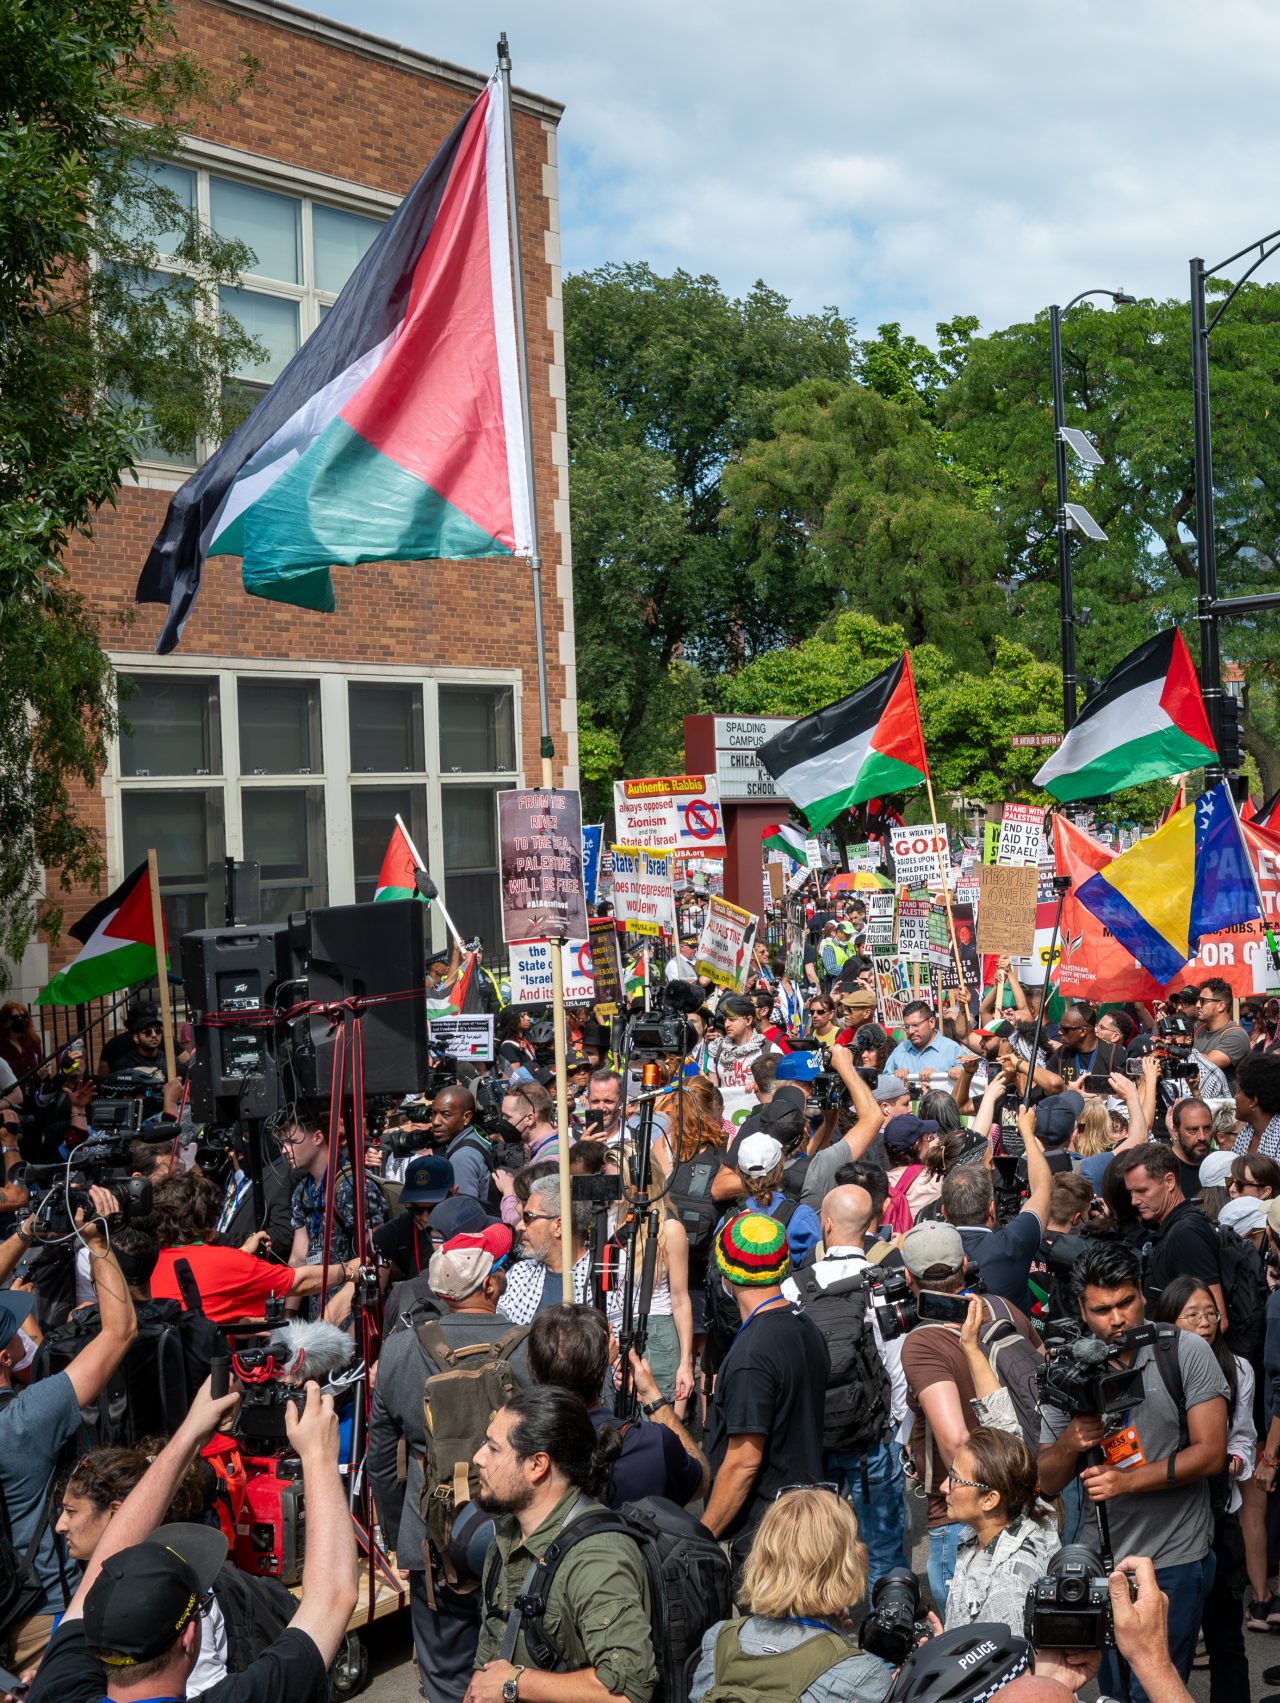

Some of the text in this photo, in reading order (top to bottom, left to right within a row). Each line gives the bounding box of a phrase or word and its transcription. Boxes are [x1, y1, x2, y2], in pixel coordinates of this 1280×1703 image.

[726, 722, 766, 733] SPALDING
[729, 736, 764, 746] CAMPUS
[627, 779, 703, 795] Authentic Rabbis
[747, 783, 777, 795] SCHOOL
[518, 795, 566, 810] FROM THE
[619, 799, 673, 814] always opposed
[1005, 805, 1045, 817] STAND WITH
[530, 815, 558, 830] RIVER
[627, 816, 666, 829] Zionism
[1004, 812, 1044, 824] PALESTINE!
[893, 829, 933, 839] THE WRATH
[1004, 823, 1040, 835] END U.S
[514, 836, 551, 851] TO THE
[653, 833, 677, 845] Israel
[1002, 833, 1039, 847] AID TO
[895, 837, 947, 856] GOD
[1001, 844, 1038, 858] ISRAEL!
[516, 857, 571, 872] PALESTINE
[612, 853, 633, 873] State
[897, 855, 935, 865] ABIDES UPON
[897, 865, 935, 874] CHILDREN
[982, 868, 1036, 888] PEOPLE
[509, 878, 580, 894] WILL BE FREE
[872, 896, 893, 910] VICTORY
[988, 887, 1031, 906] OVER
[900, 920, 916, 928] END
[1224, 923, 1256, 936] JOBS,
[900, 929, 916, 939] AID
[529, 945, 546, 957] the
[519, 961, 546, 972] State
[876, 959, 891, 974] NO
[519, 988, 540, 1001] And
[1104, 1436, 1126, 1452] PRESS
[958, 1640, 998, 1671] POLICE
